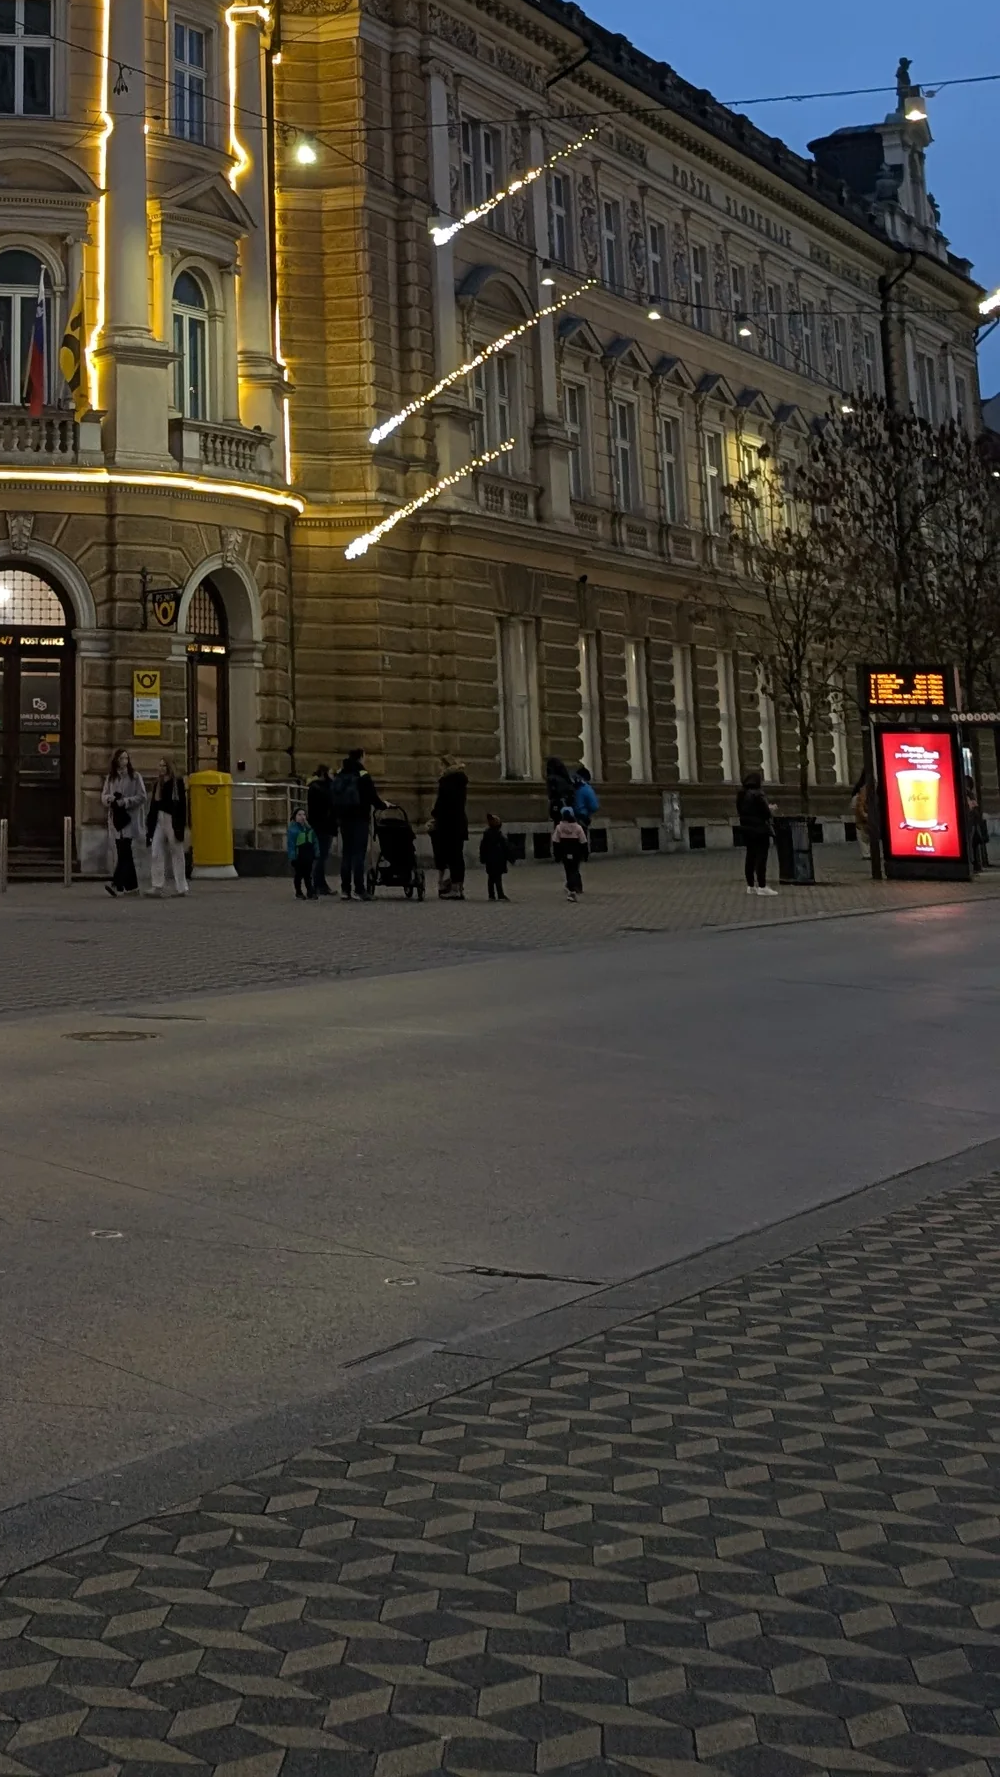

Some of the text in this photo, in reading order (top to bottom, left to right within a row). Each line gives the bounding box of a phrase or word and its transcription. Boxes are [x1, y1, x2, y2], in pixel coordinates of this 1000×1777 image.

[672, 163, 792, 247] POŠTA SLOVENIJE
[20, 636, 39, 645] POST
